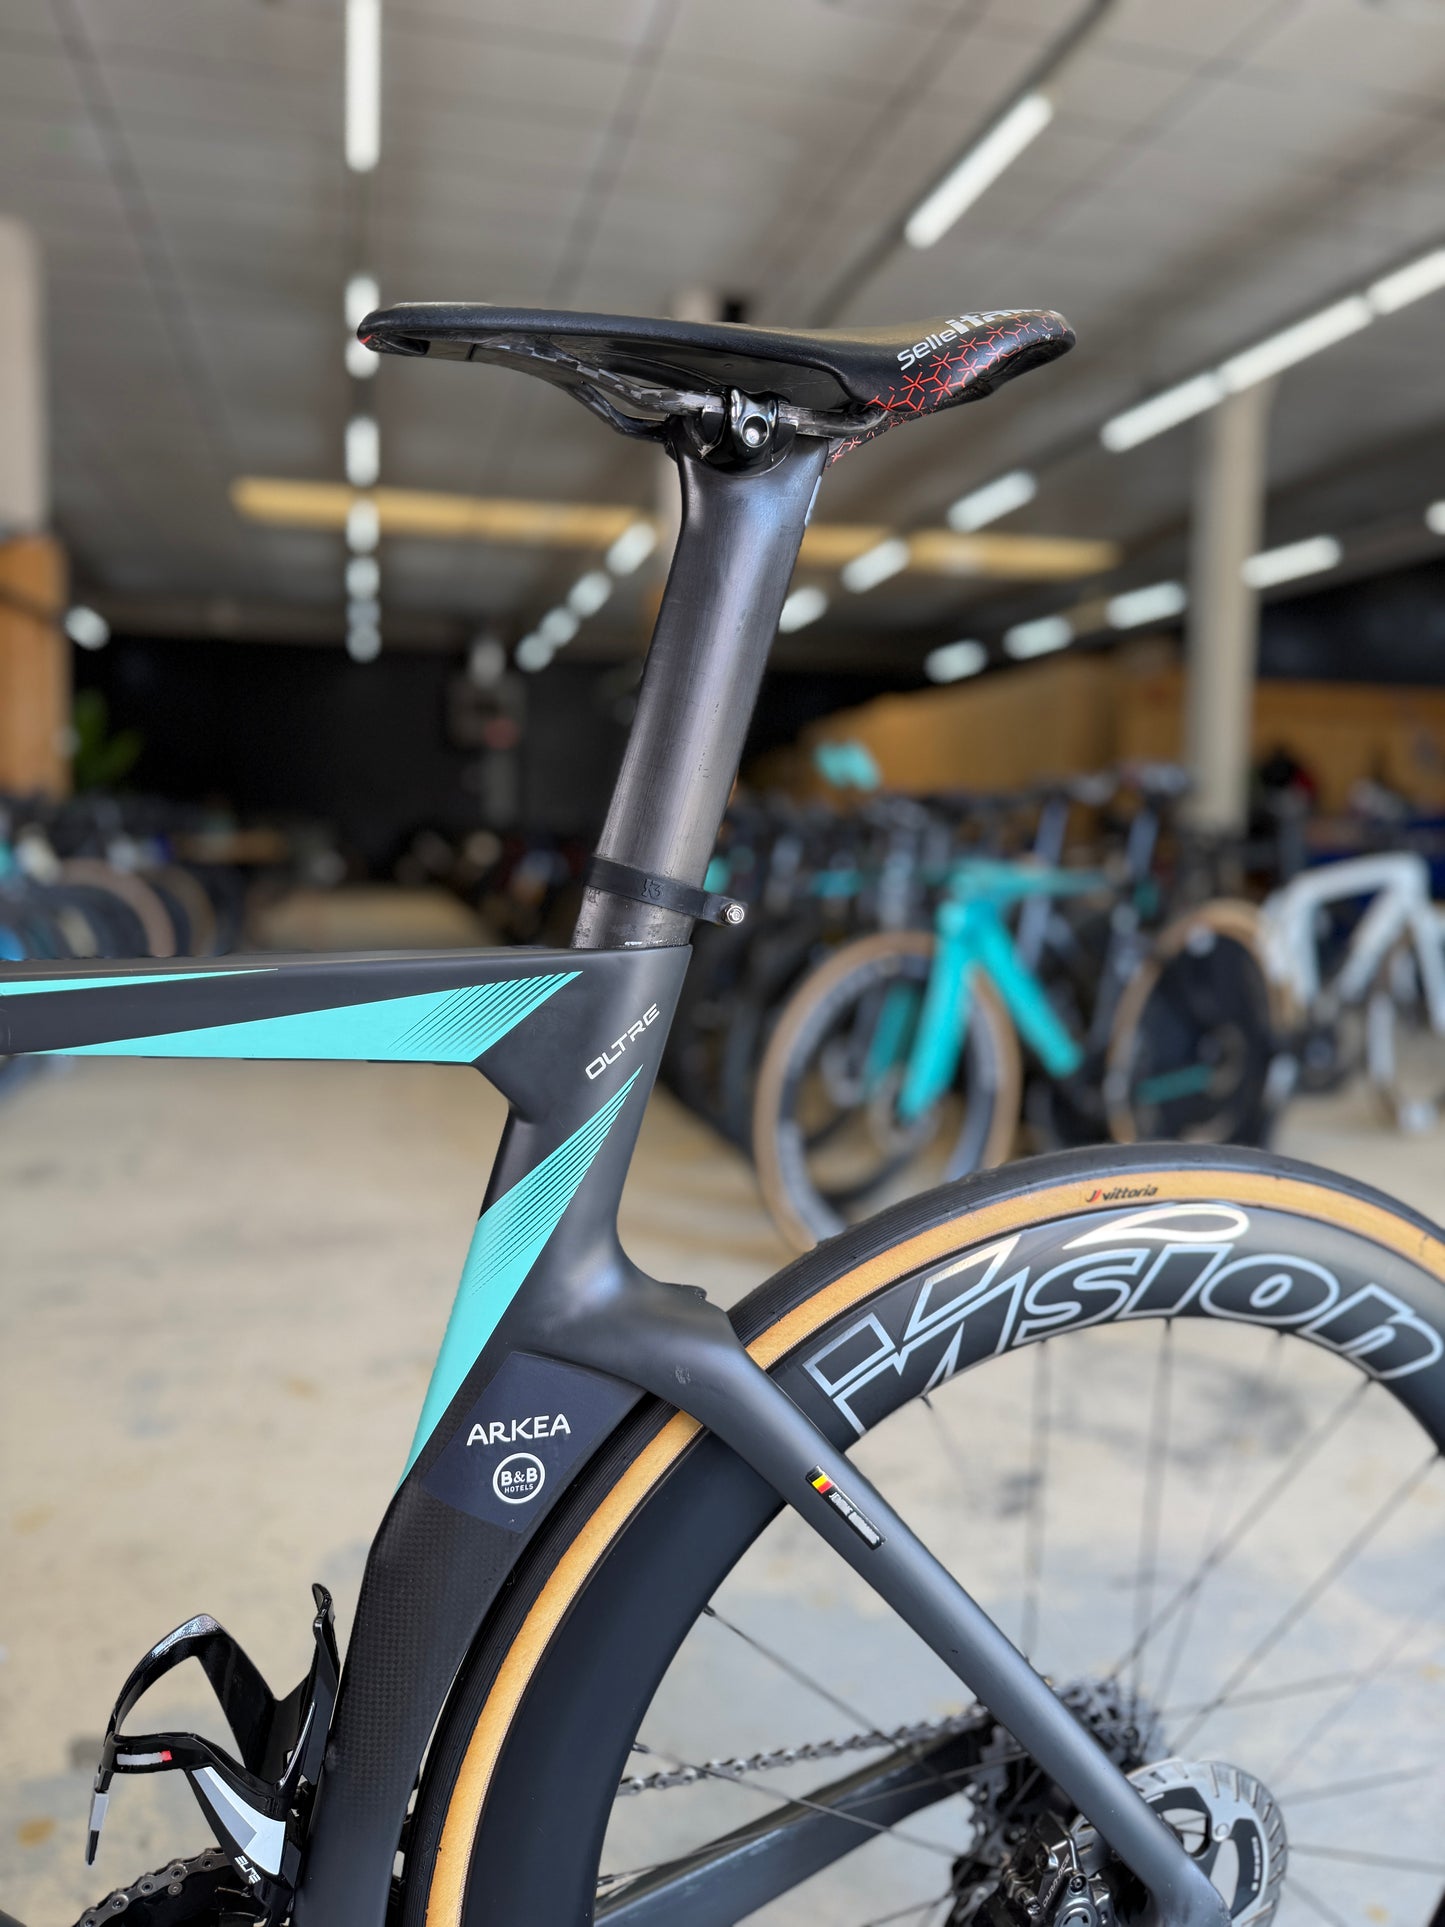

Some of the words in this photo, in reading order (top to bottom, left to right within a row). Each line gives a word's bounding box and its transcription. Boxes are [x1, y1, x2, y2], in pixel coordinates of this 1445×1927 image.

[585, 1003, 660, 1080] OLTRE
[1103, 1184, 1159, 1201] vittoria
[466, 1413, 572, 1446] ARKEA
[501, 1467, 538, 1487] B&B
[504, 1483, 534, 1494] HOTELS
